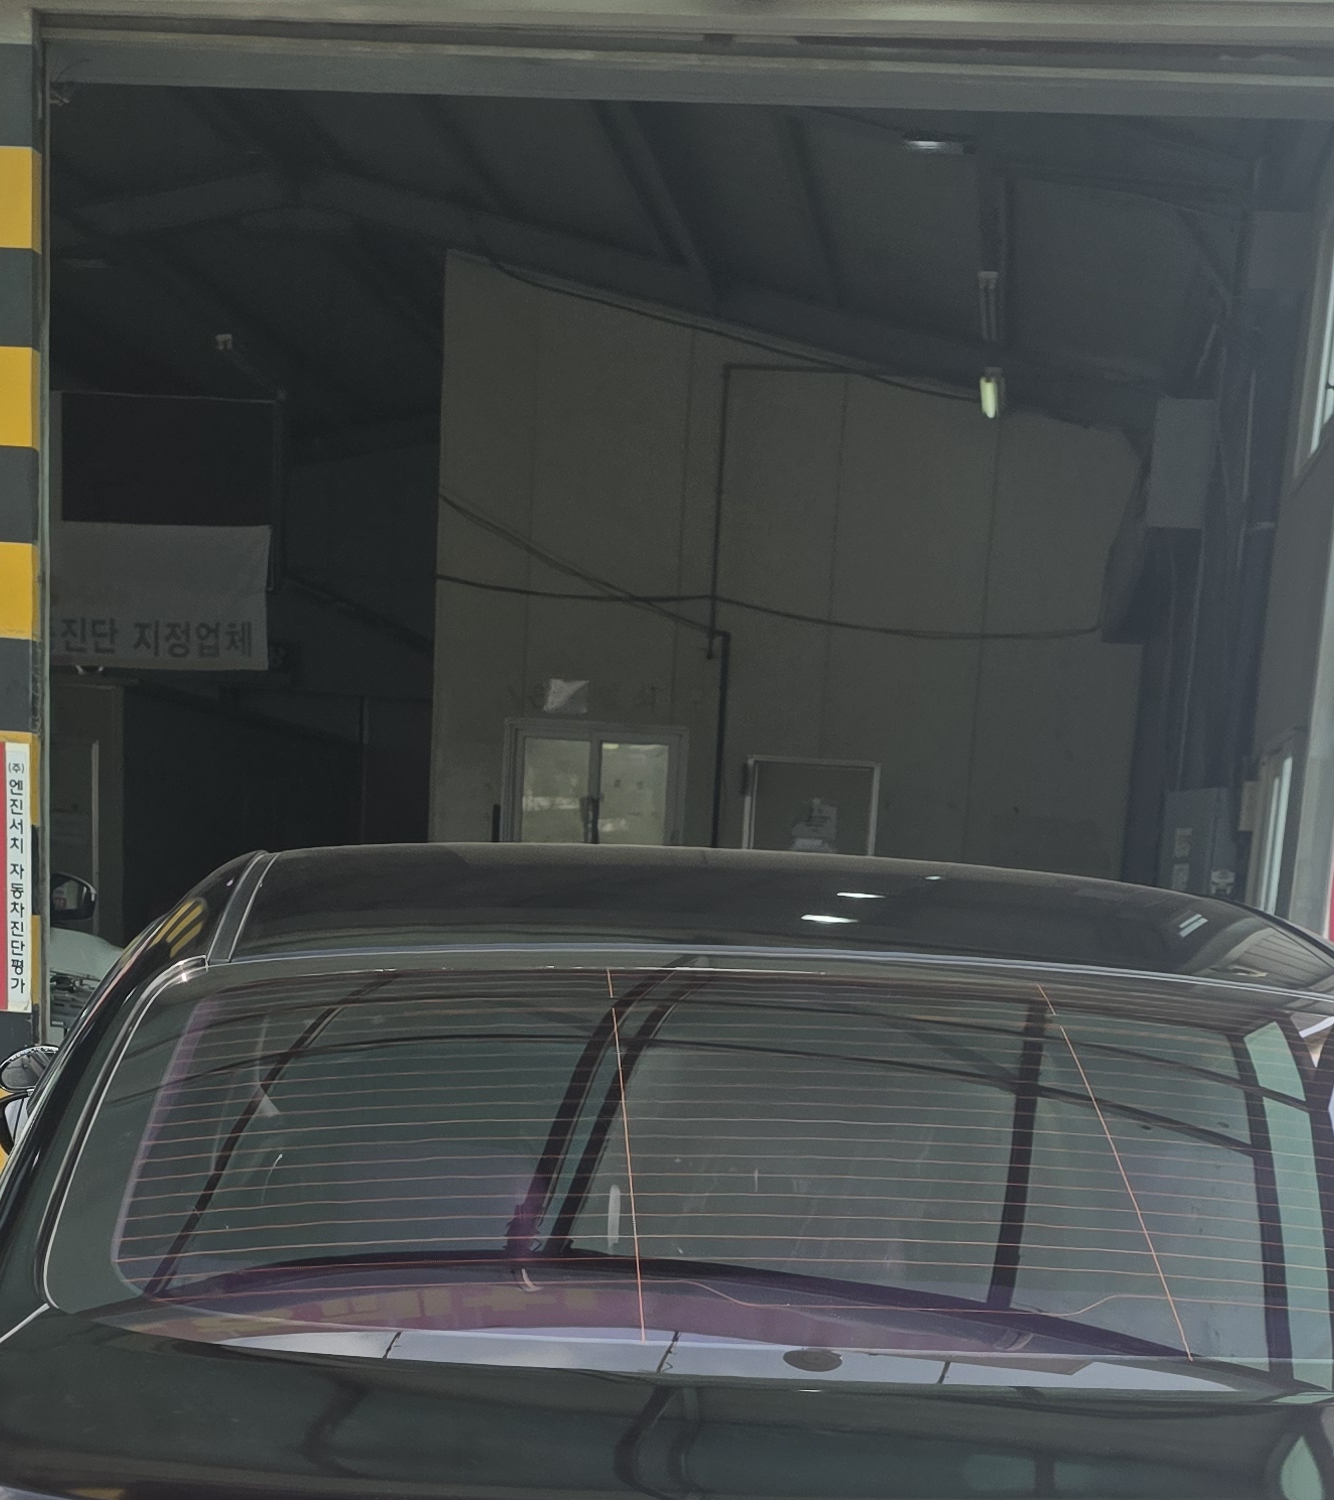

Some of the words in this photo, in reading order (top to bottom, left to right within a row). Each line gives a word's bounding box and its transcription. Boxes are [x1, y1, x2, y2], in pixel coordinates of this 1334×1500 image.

[51, 617, 119, 655] 진단
[133, 620, 253, 658] 지정업체
[9, 863, 26, 994] 자동차진단평가
